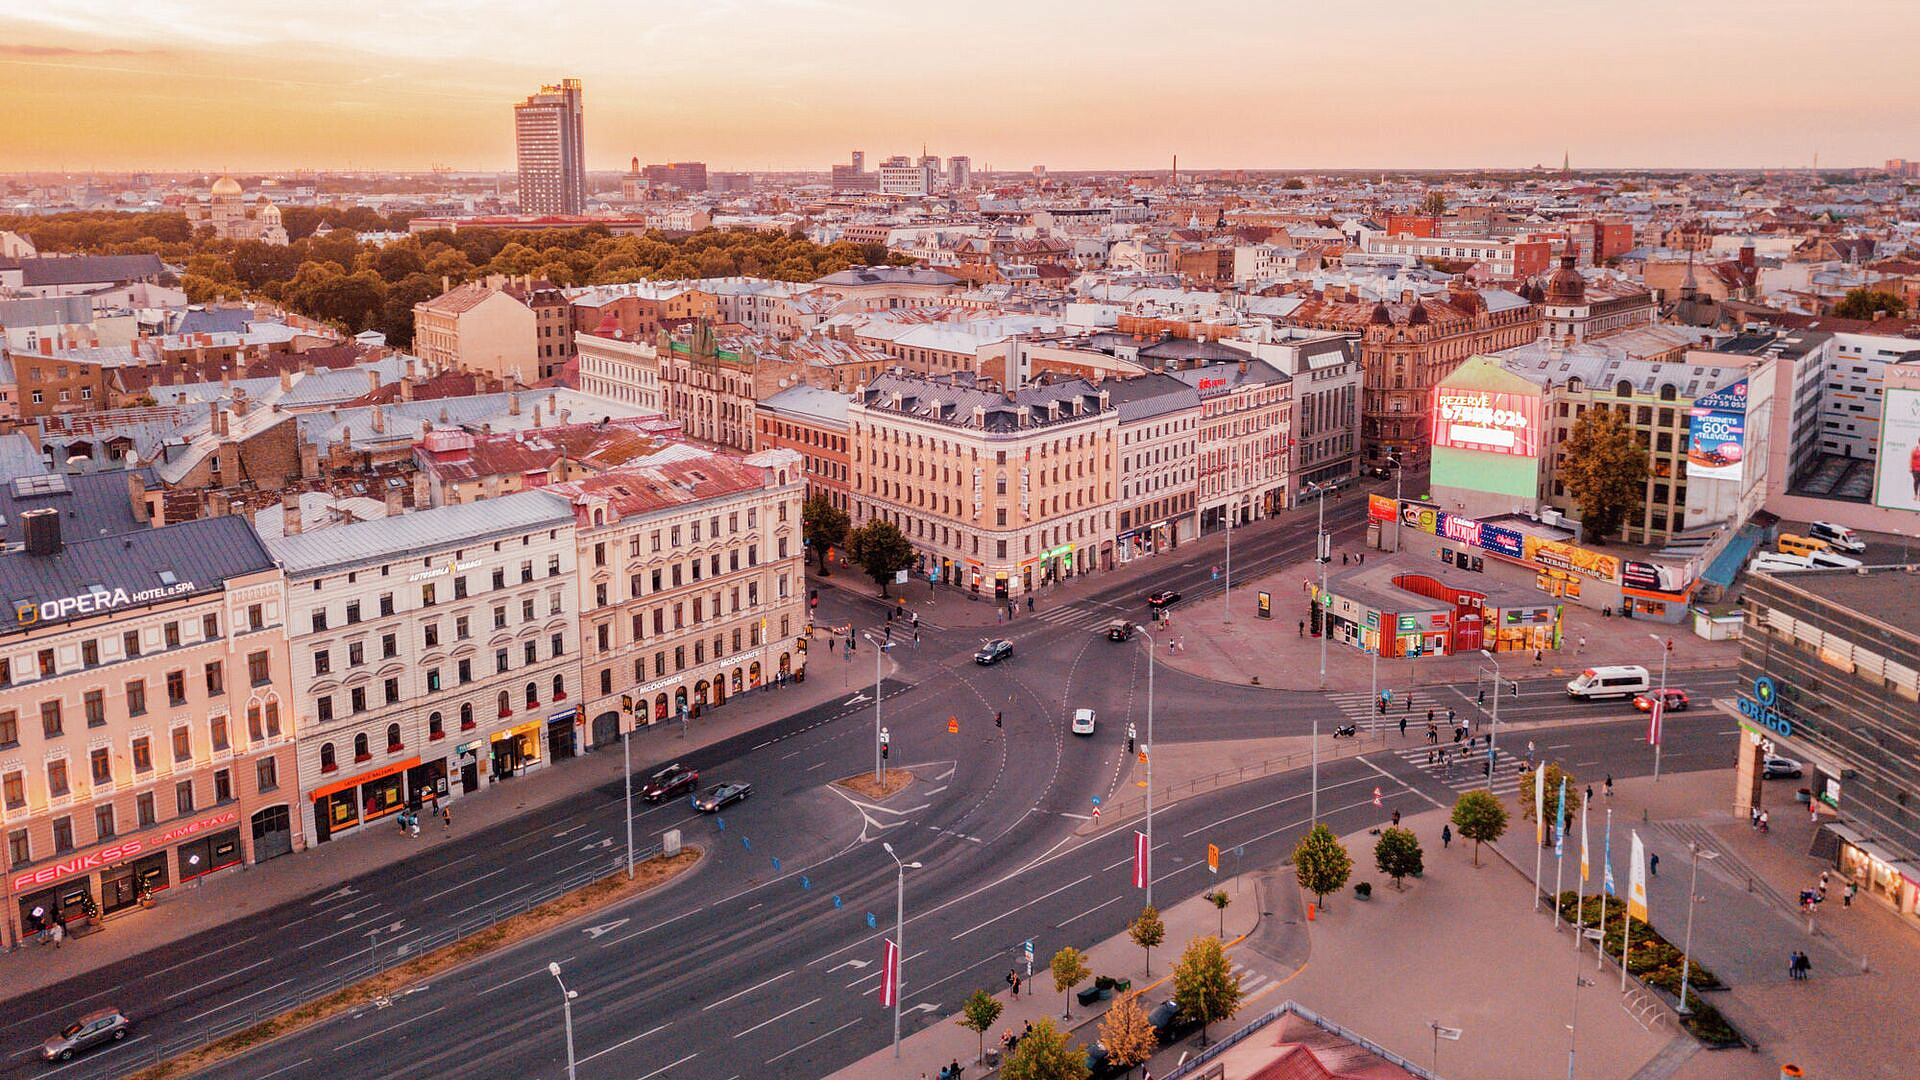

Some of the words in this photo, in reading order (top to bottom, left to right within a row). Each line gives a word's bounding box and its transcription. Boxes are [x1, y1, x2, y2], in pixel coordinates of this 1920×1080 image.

[1703, 423, 1729, 434] 600
[41, 588, 130, 620] OPERA
[133, 587, 168, 602] HOTEL
[175, 581, 195, 592] SPA
[1737, 698, 1792, 737] ORIGO
[13, 840, 142, 890] FENIKSS
